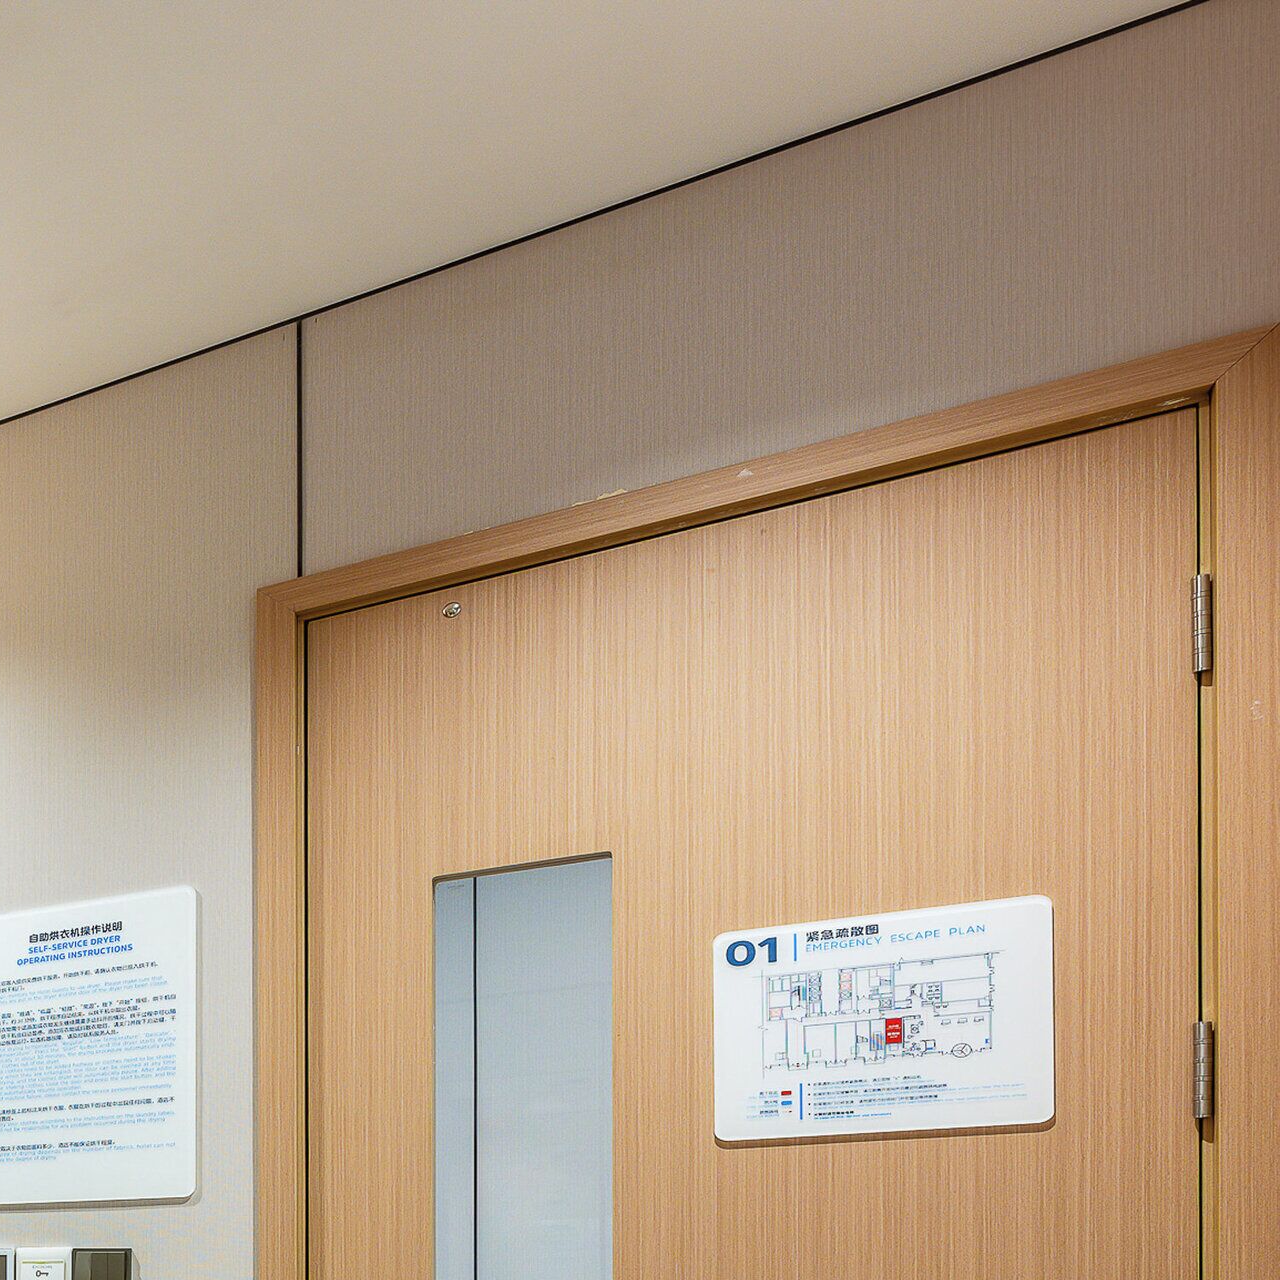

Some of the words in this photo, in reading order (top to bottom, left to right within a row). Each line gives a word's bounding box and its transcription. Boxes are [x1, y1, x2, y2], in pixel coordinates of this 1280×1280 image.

[29, 921, 123, 943] 自助烘衣机操作说明
[805, 936, 883, 952] EMERGENCY
[891, 929, 941, 943] ESCAPE
[949, 924, 986, 936] PLAN
[806, 924, 879, 942] 紧急疏散图
[17, 952, 66, 966] OPERATING
[68, 943, 134, 959] INSTRUCTIONS
[28, 938, 88, 954] SELF-SERVICE
[90, 935, 121, 946] DRYER
[726, 936, 778, 967] 01
